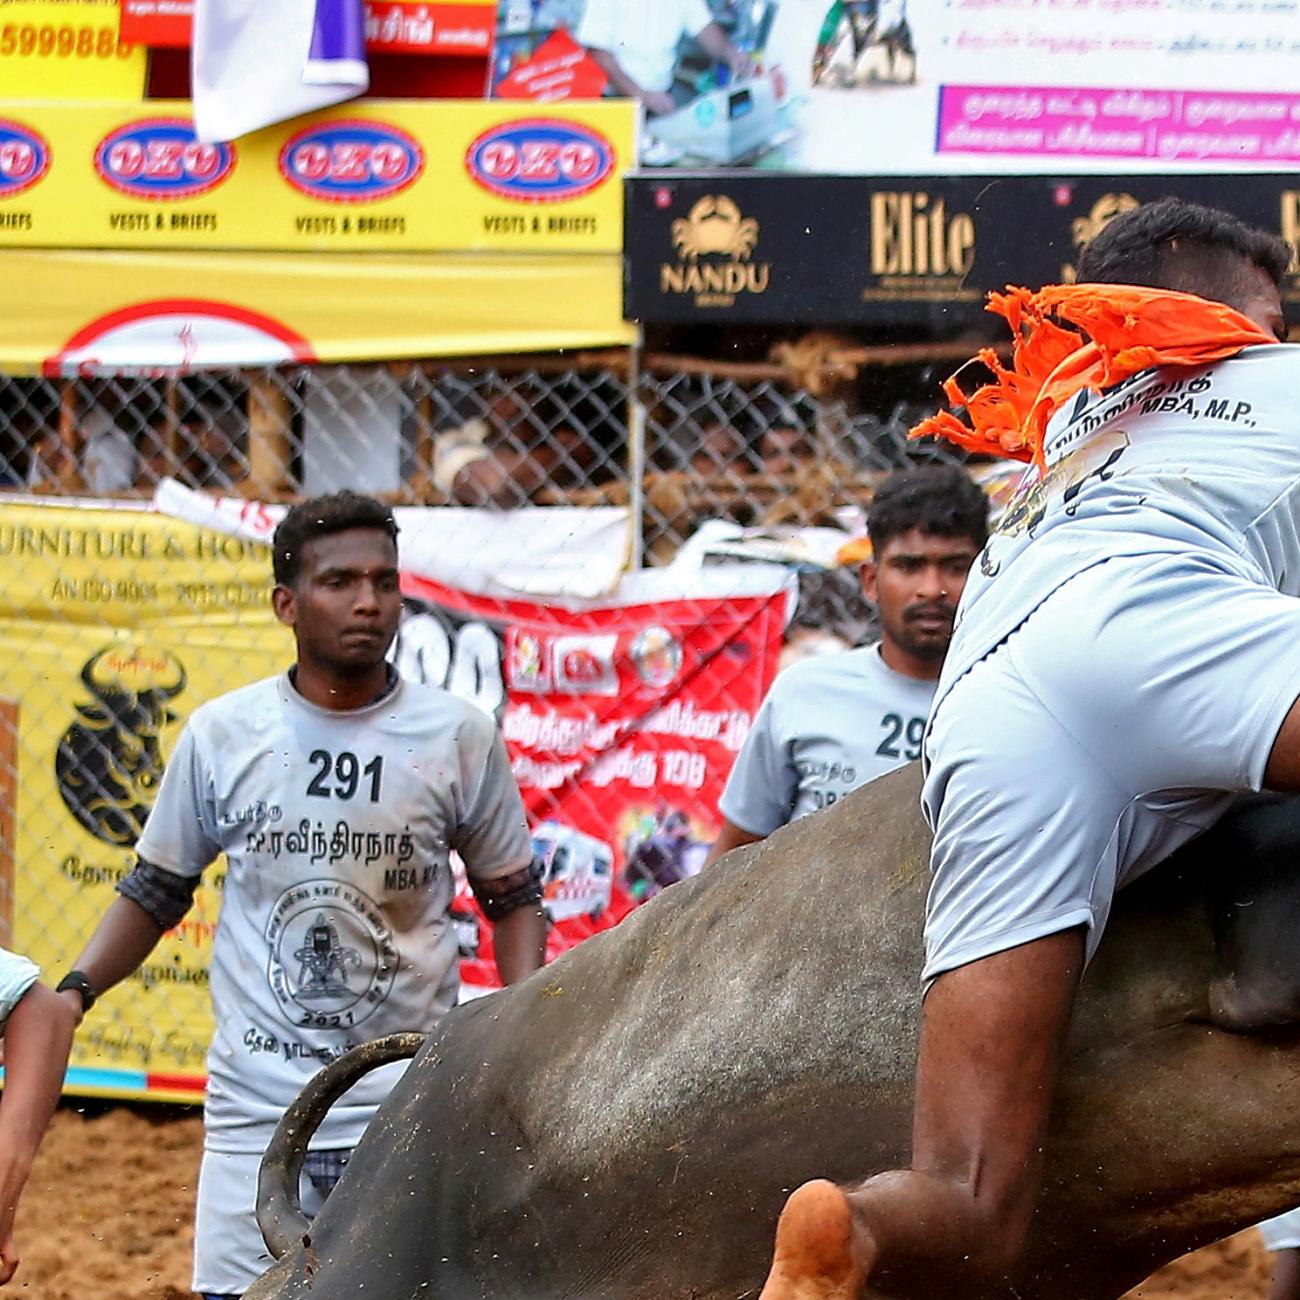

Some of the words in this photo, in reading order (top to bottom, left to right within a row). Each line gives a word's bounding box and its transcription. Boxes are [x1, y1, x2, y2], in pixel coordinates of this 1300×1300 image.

[110, 213, 149, 230] VESTS
[155, 214, 165, 231] &
[171, 214, 218, 231] BRIEFS
[296, 217, 336, 234] VESTS
[342, 217, 351, 232] &
[358, 217, 407, 234] BRIEFS
[484, 217, 524, 234] VESTS
[531, 217, 541, 233] &
[548, 217, 597, 234] BRIEFS
[870, 191, 976, 276] Elite
[660, 262, 771, 294] NANDU
[0, 528, 149, 560] URNITURE
[306, 749, 384, 802] 291
[301, 1011, 354, 1026] 2021
